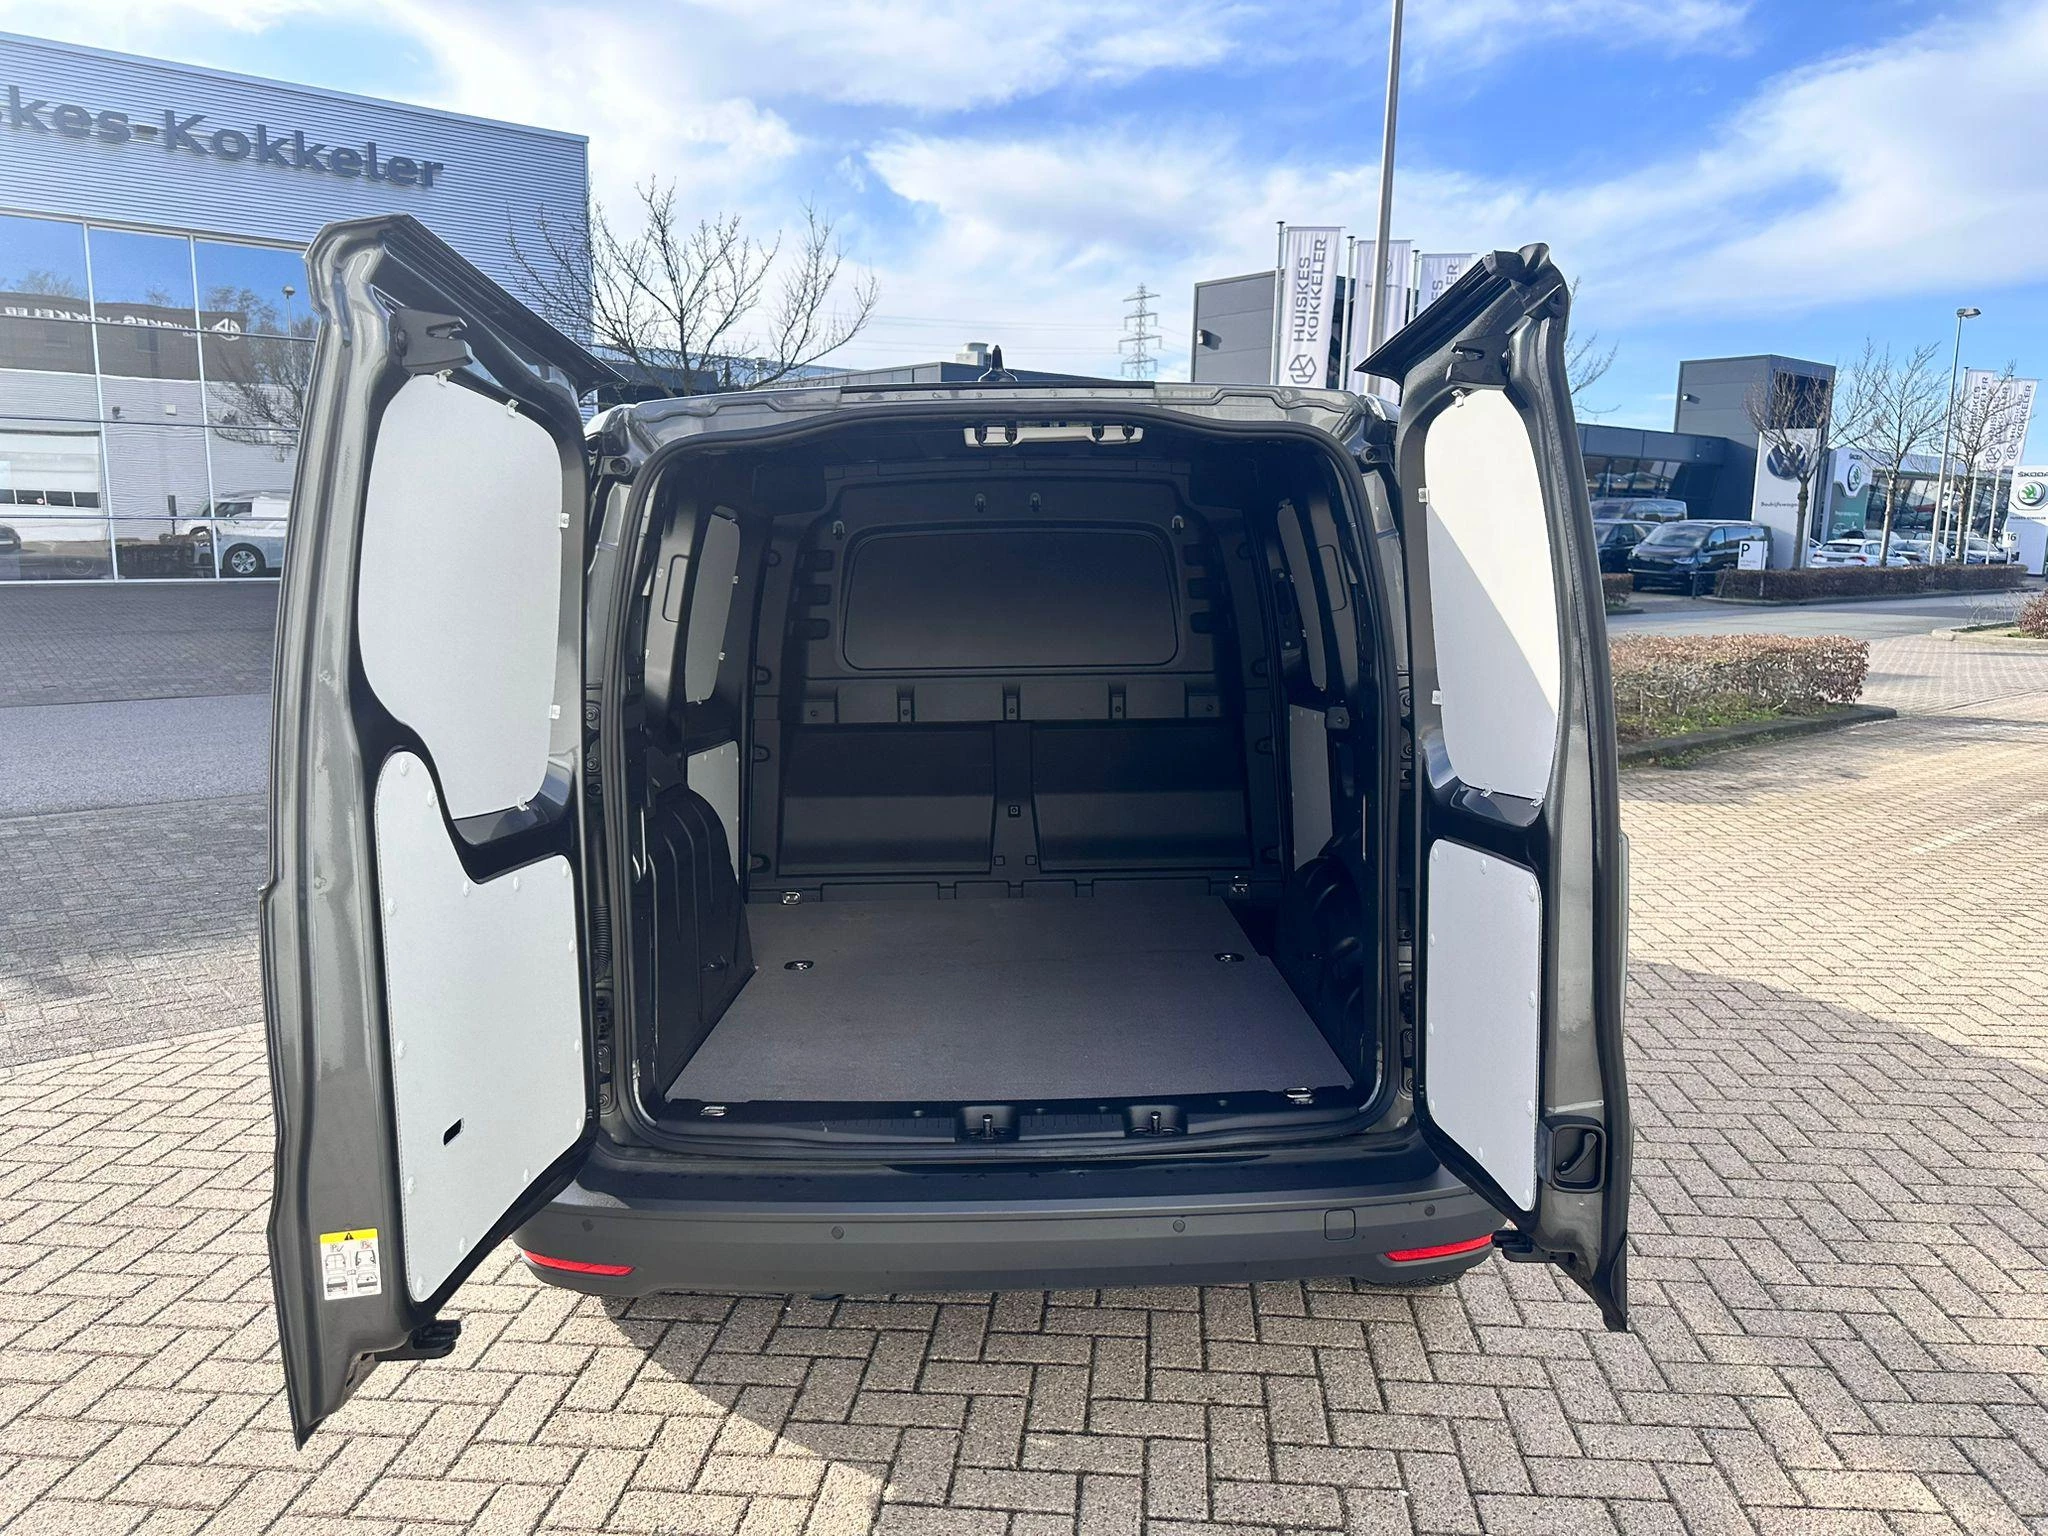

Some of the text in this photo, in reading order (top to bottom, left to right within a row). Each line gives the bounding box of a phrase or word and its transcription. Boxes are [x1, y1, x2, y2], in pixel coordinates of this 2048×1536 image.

[0, 84, 444, 188] kes-Kokkeler
[1293, 257, 1310, 342] HUISKES
[1306, 238, 1327, 342] KOKKELER
[2016, 384, 2031, 439] KOKKELER
[1741, 543, 1750, 557] P
